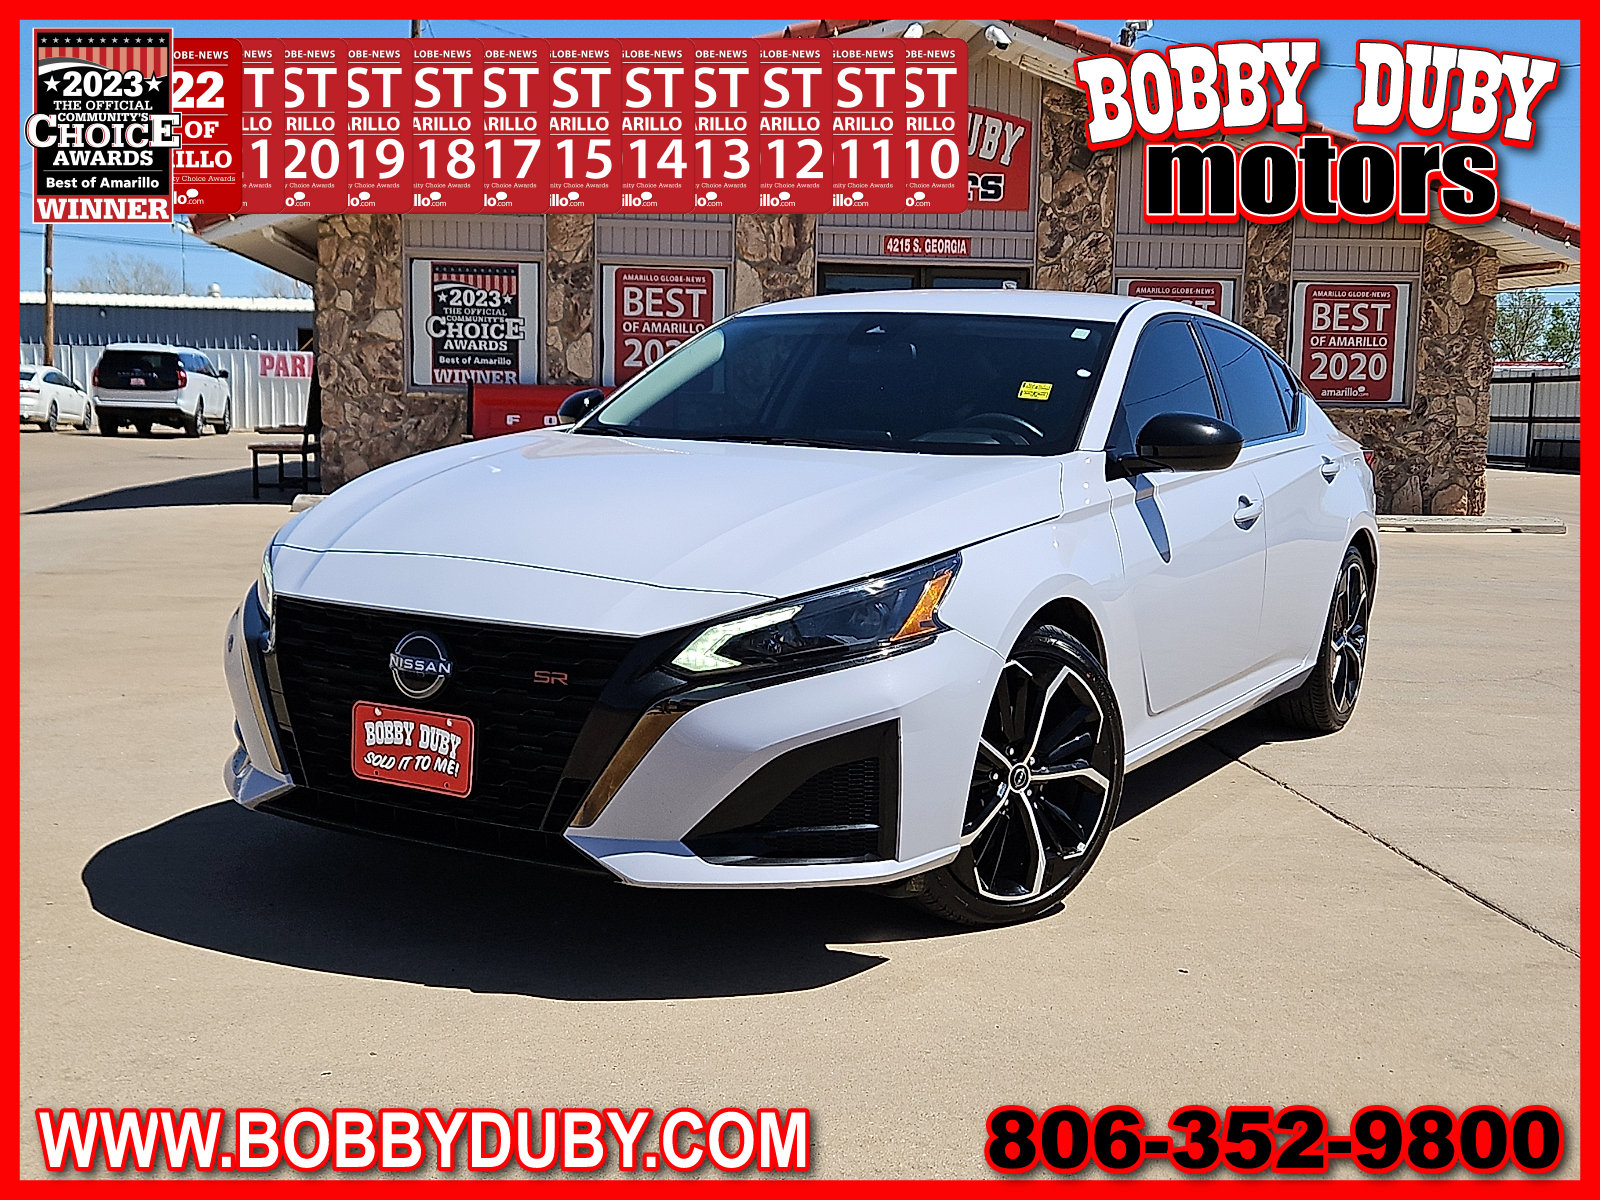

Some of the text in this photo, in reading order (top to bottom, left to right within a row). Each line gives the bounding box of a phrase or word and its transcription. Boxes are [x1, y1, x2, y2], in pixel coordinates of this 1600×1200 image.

[887, 237, 967, 254] 4215 S. GEORGIA
[622, 273, 706, 283] AMARILLO GLOBE-NEWS
[449, 289, 501, 308] 2023
[1135, 286, 1215, 295] AMARILLO GLOBE-NEWS
[1312, 290, 1347, 298] AMARILLO
[623, 286, 707, 318] BEST
[443, 307, 508, 316] THE OFFICIAL
[1312, 302, 1391, 331] BEST
[426, 314, 525, 340] CHOICE
[622, 321, 705, 334] OF AMARILLO
[443, 340, 508, 351] AWARDS
[1310, 336, 1388, 347] OF AMARILLO
[440, 356, 512, 366] Best of Amarillo
[1309, 352, 1387, 380] 2020
[433, 369, 518, 384] WINNER
[389, 653, 451, 674] NISSAN
[533, 670, 568, 686] SR
[364, 720, 462, 759] BOBBY DUBY
[364, 751, 460, 778] SOLD IT TO ME!
